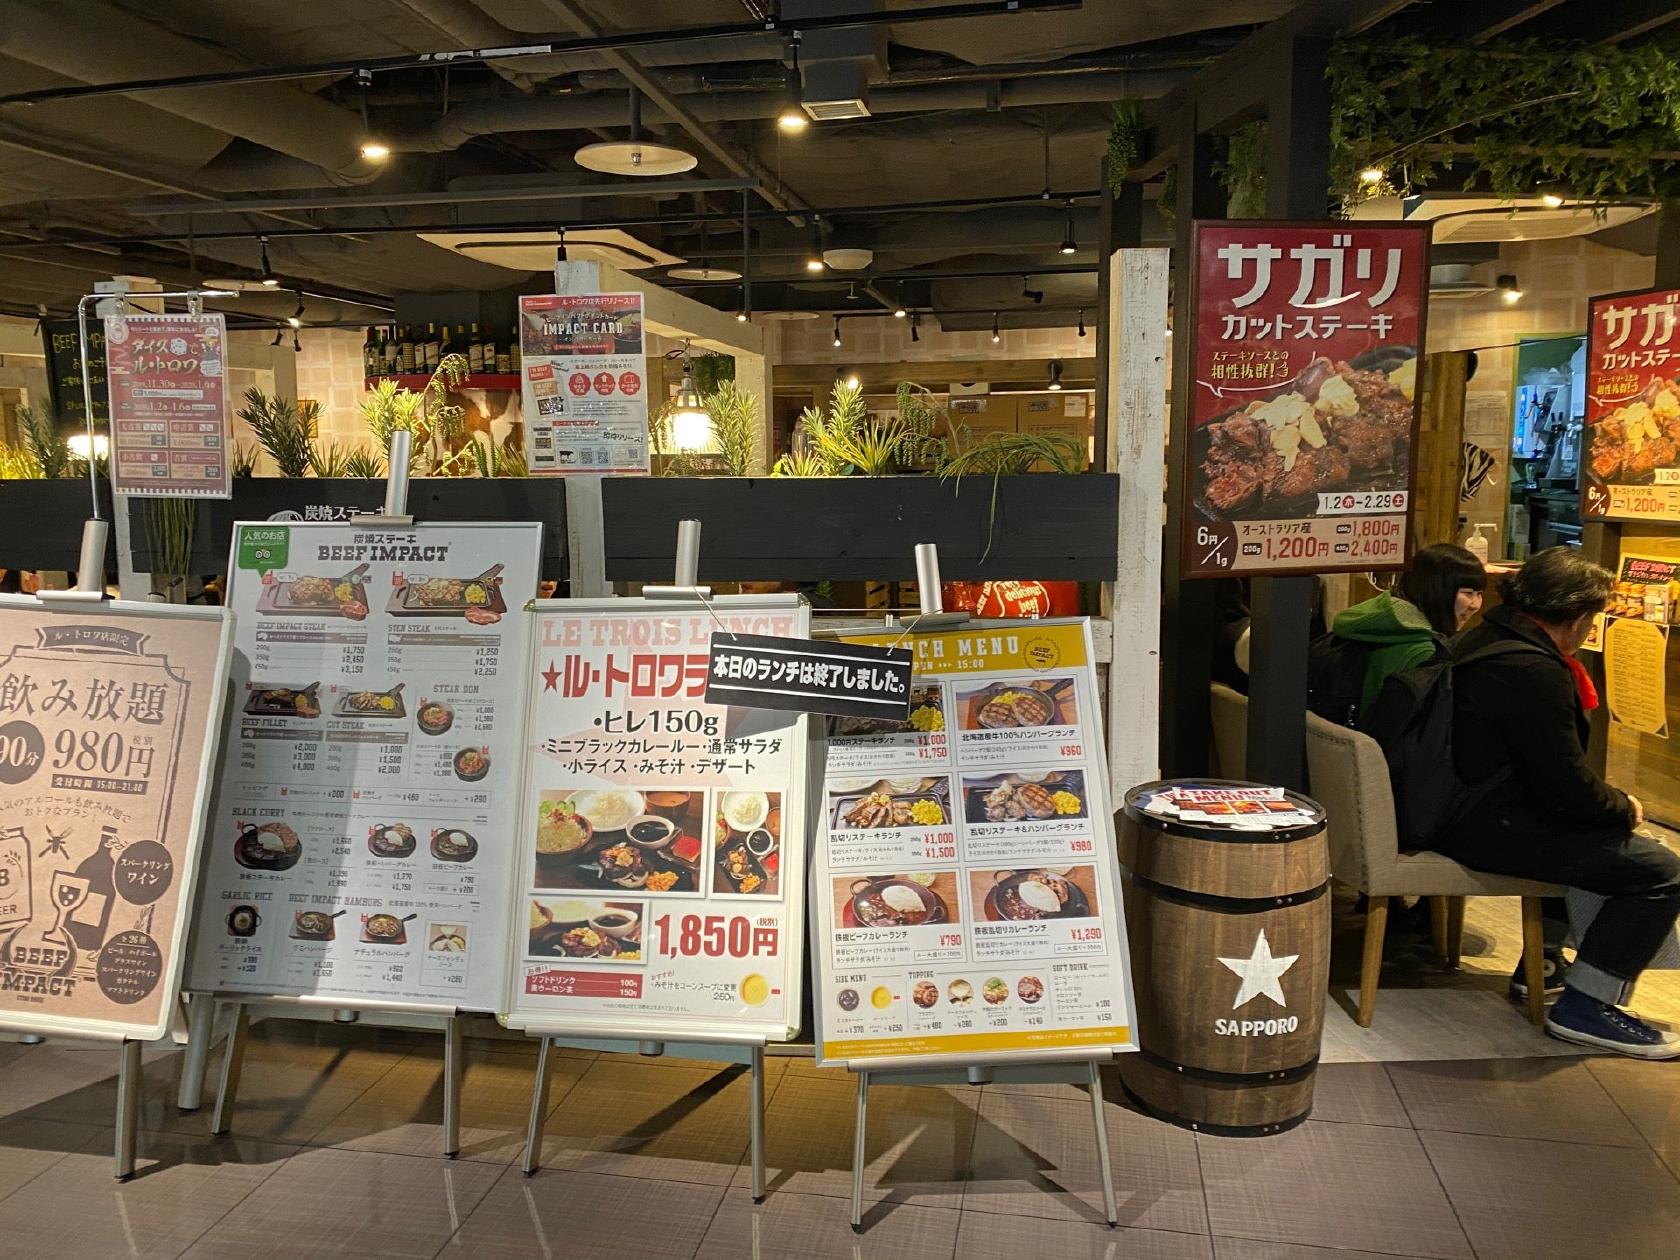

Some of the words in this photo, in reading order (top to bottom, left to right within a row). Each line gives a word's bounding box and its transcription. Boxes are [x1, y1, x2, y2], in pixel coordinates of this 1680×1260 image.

[1218, 234, 1402, 309] サガリ
[543, 323, 588, 336] IMPACT
[593, 322, 623, 334] CARD
[1221, 313, 1393, 340] カットステーキ
[1212, 351, 1289, 361] ステーキソースとの
[1626, 497, 1665, 512] 1,200円
[1242, 523, 1312, 535] オーストラリア産
[1353, 520, 1400, 537] 1,800円
[244, 531, 285, 540] 人気のお店
[353, 533, 417, 544] 炭焼ステーキ
[318, 546, 369, 561] BEEF
[370, 546, 448, 562] IMPACT
[1243, 545, 1262, 554] 200g
[1266, 537, 1329, 560] 1,200円
[1351, 539, 1398, 557] 2,400円
[542, 620, 582, 647] LE
[590, 618, 682, 647] TROIS
[957, 636, 1020, 656] MENU
[957, 659, 985, 669] 15:00
[713, 653, 905, 694] 本日のランチは終了しました。
[433, 685, 460, 693] STEAK
[0, 673, 169, 725] 飲み放題
[52, 729, 155, 779] 980円
[232, 808, 258, 816] BLACK
[924, 832, 954, 844] ¥1,000
[925, 847, 955, 858] ¥1,500
[1070, 841, 1092, 851] ¥980
[120, 858, 171, 870] スパークリング
[128, 873, 159, 885] ワイン
[654, 914, 779, 960] 1,850円
[835, 931, 908, 942] 鉄板ビーフカレーランチ
[939, 934, 962, 946] ¥790
[1071, 928, 1102, 940] ¥1,290
[13, 947, 68, 967] BEEF
[0, 974, 76, 997] MPACT
[531, 976, 576, 984] ソフトドリンク
[530, 984, 574, 993] 黒ウーロン茶
[1215, 1016, 1299, 1036] SAPPORO
